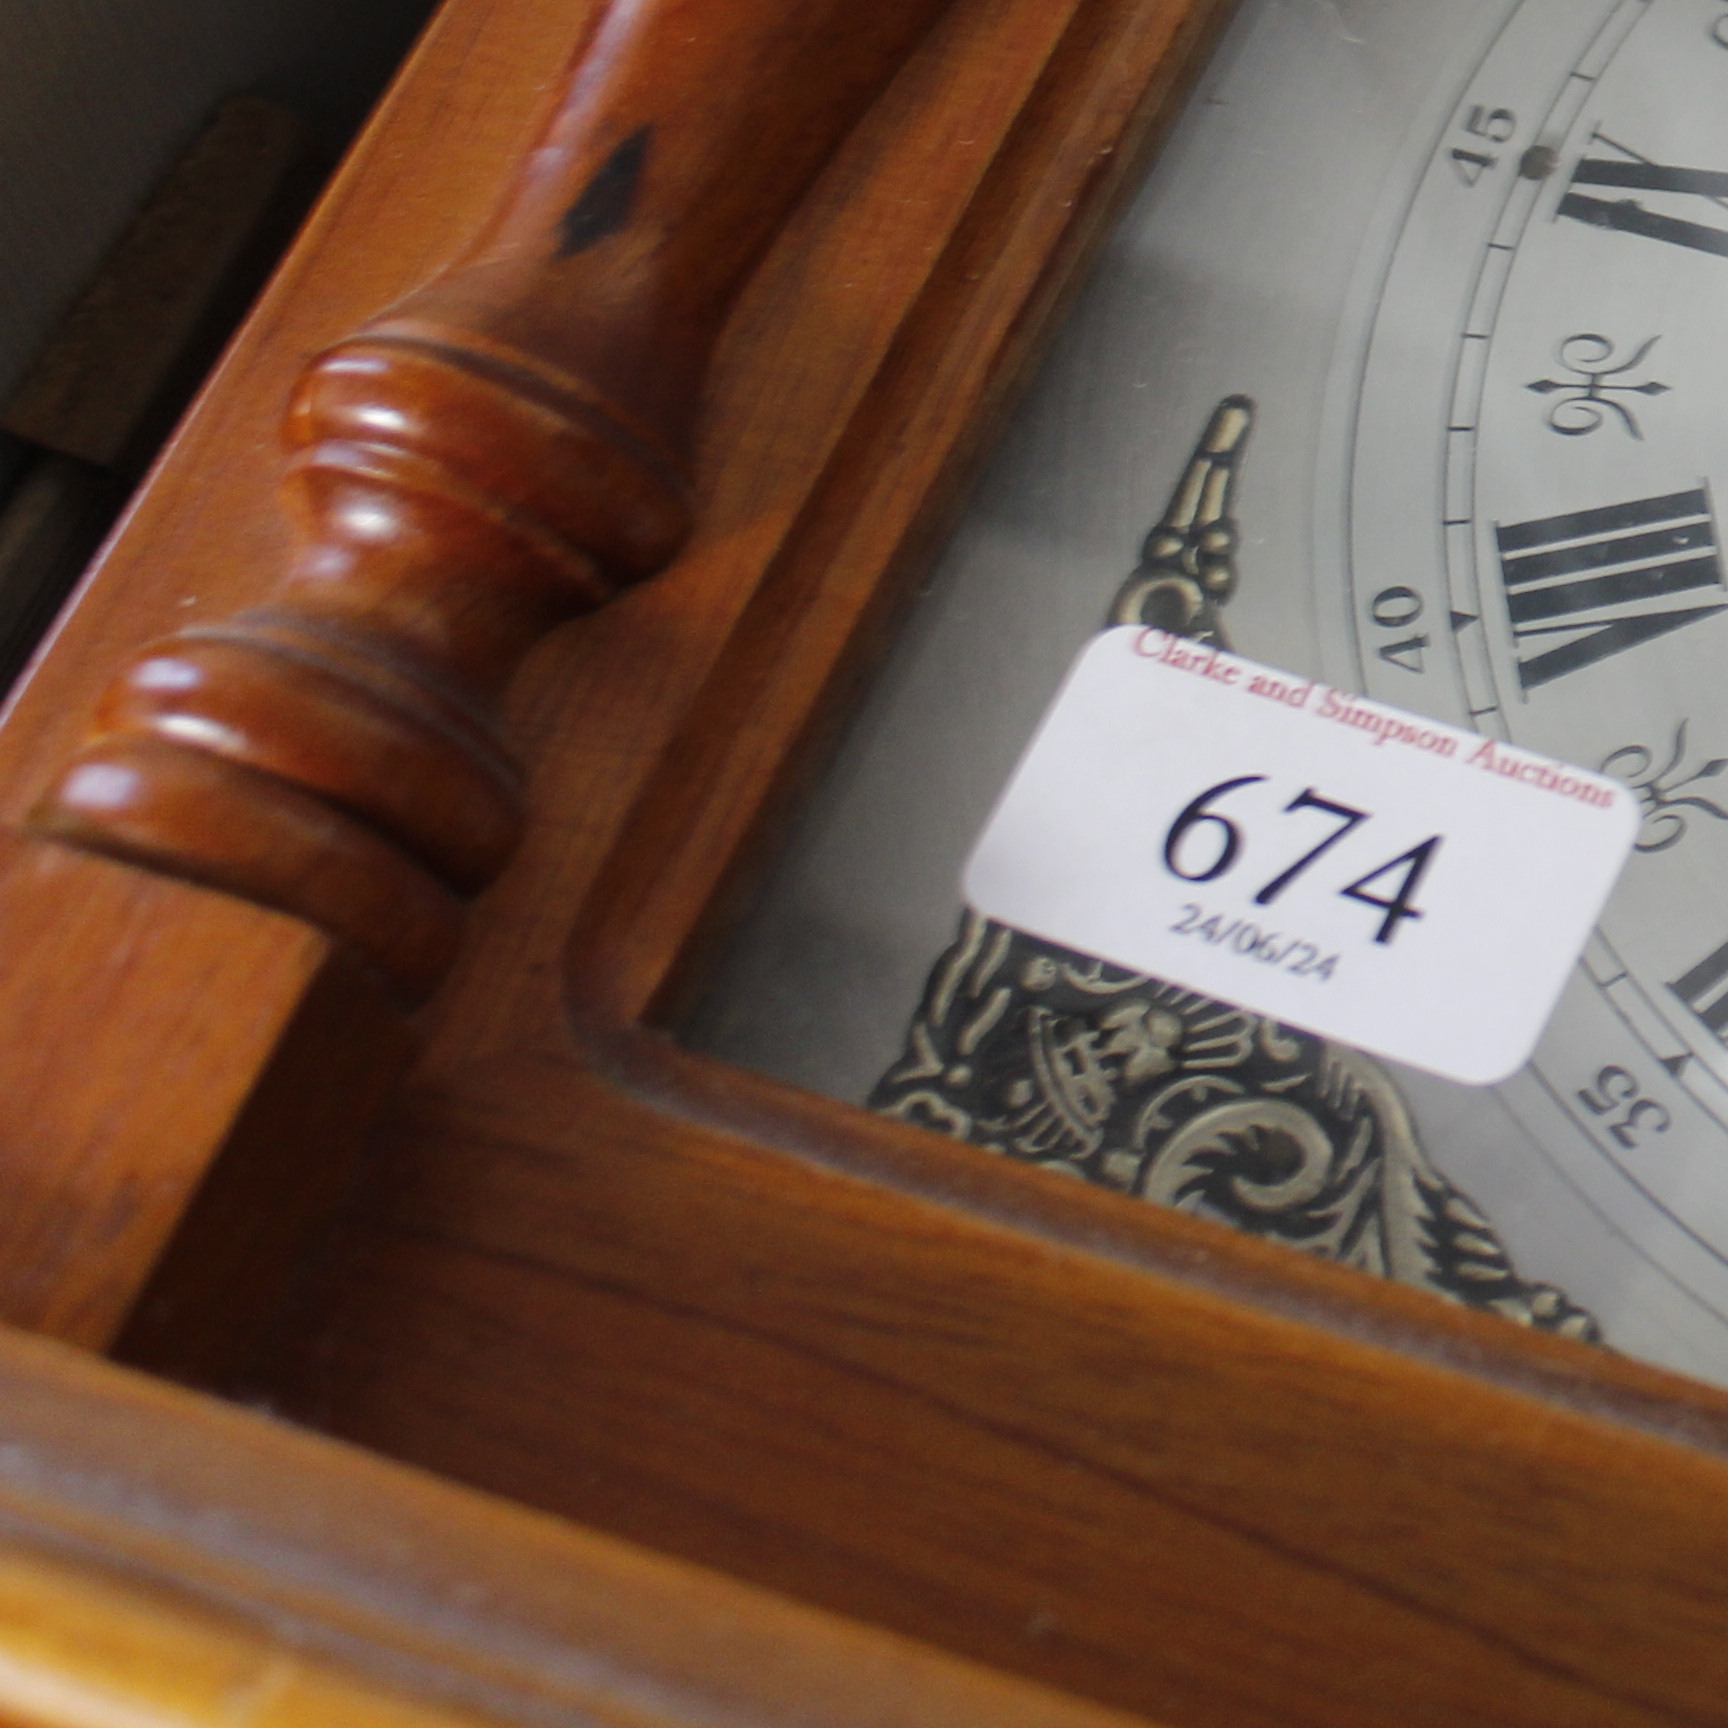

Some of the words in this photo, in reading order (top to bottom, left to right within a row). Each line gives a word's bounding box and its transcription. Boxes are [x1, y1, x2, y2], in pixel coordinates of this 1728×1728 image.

[1448, 105, 1518, 188] 45
[1371, 585, 1431, 674] 40
[1131, 624, 1240, 688] Clarke
[1247, 672, 1310, 710] and
[1316, 688, 1457, 758] Simpson
[1466, 739, 1615, 810] Auctions
[1161, 774, 1446, 946] 674
[1169, 902, 1342, 984] 24/06/24
[1575, 1063, 1673, 1150] 35
